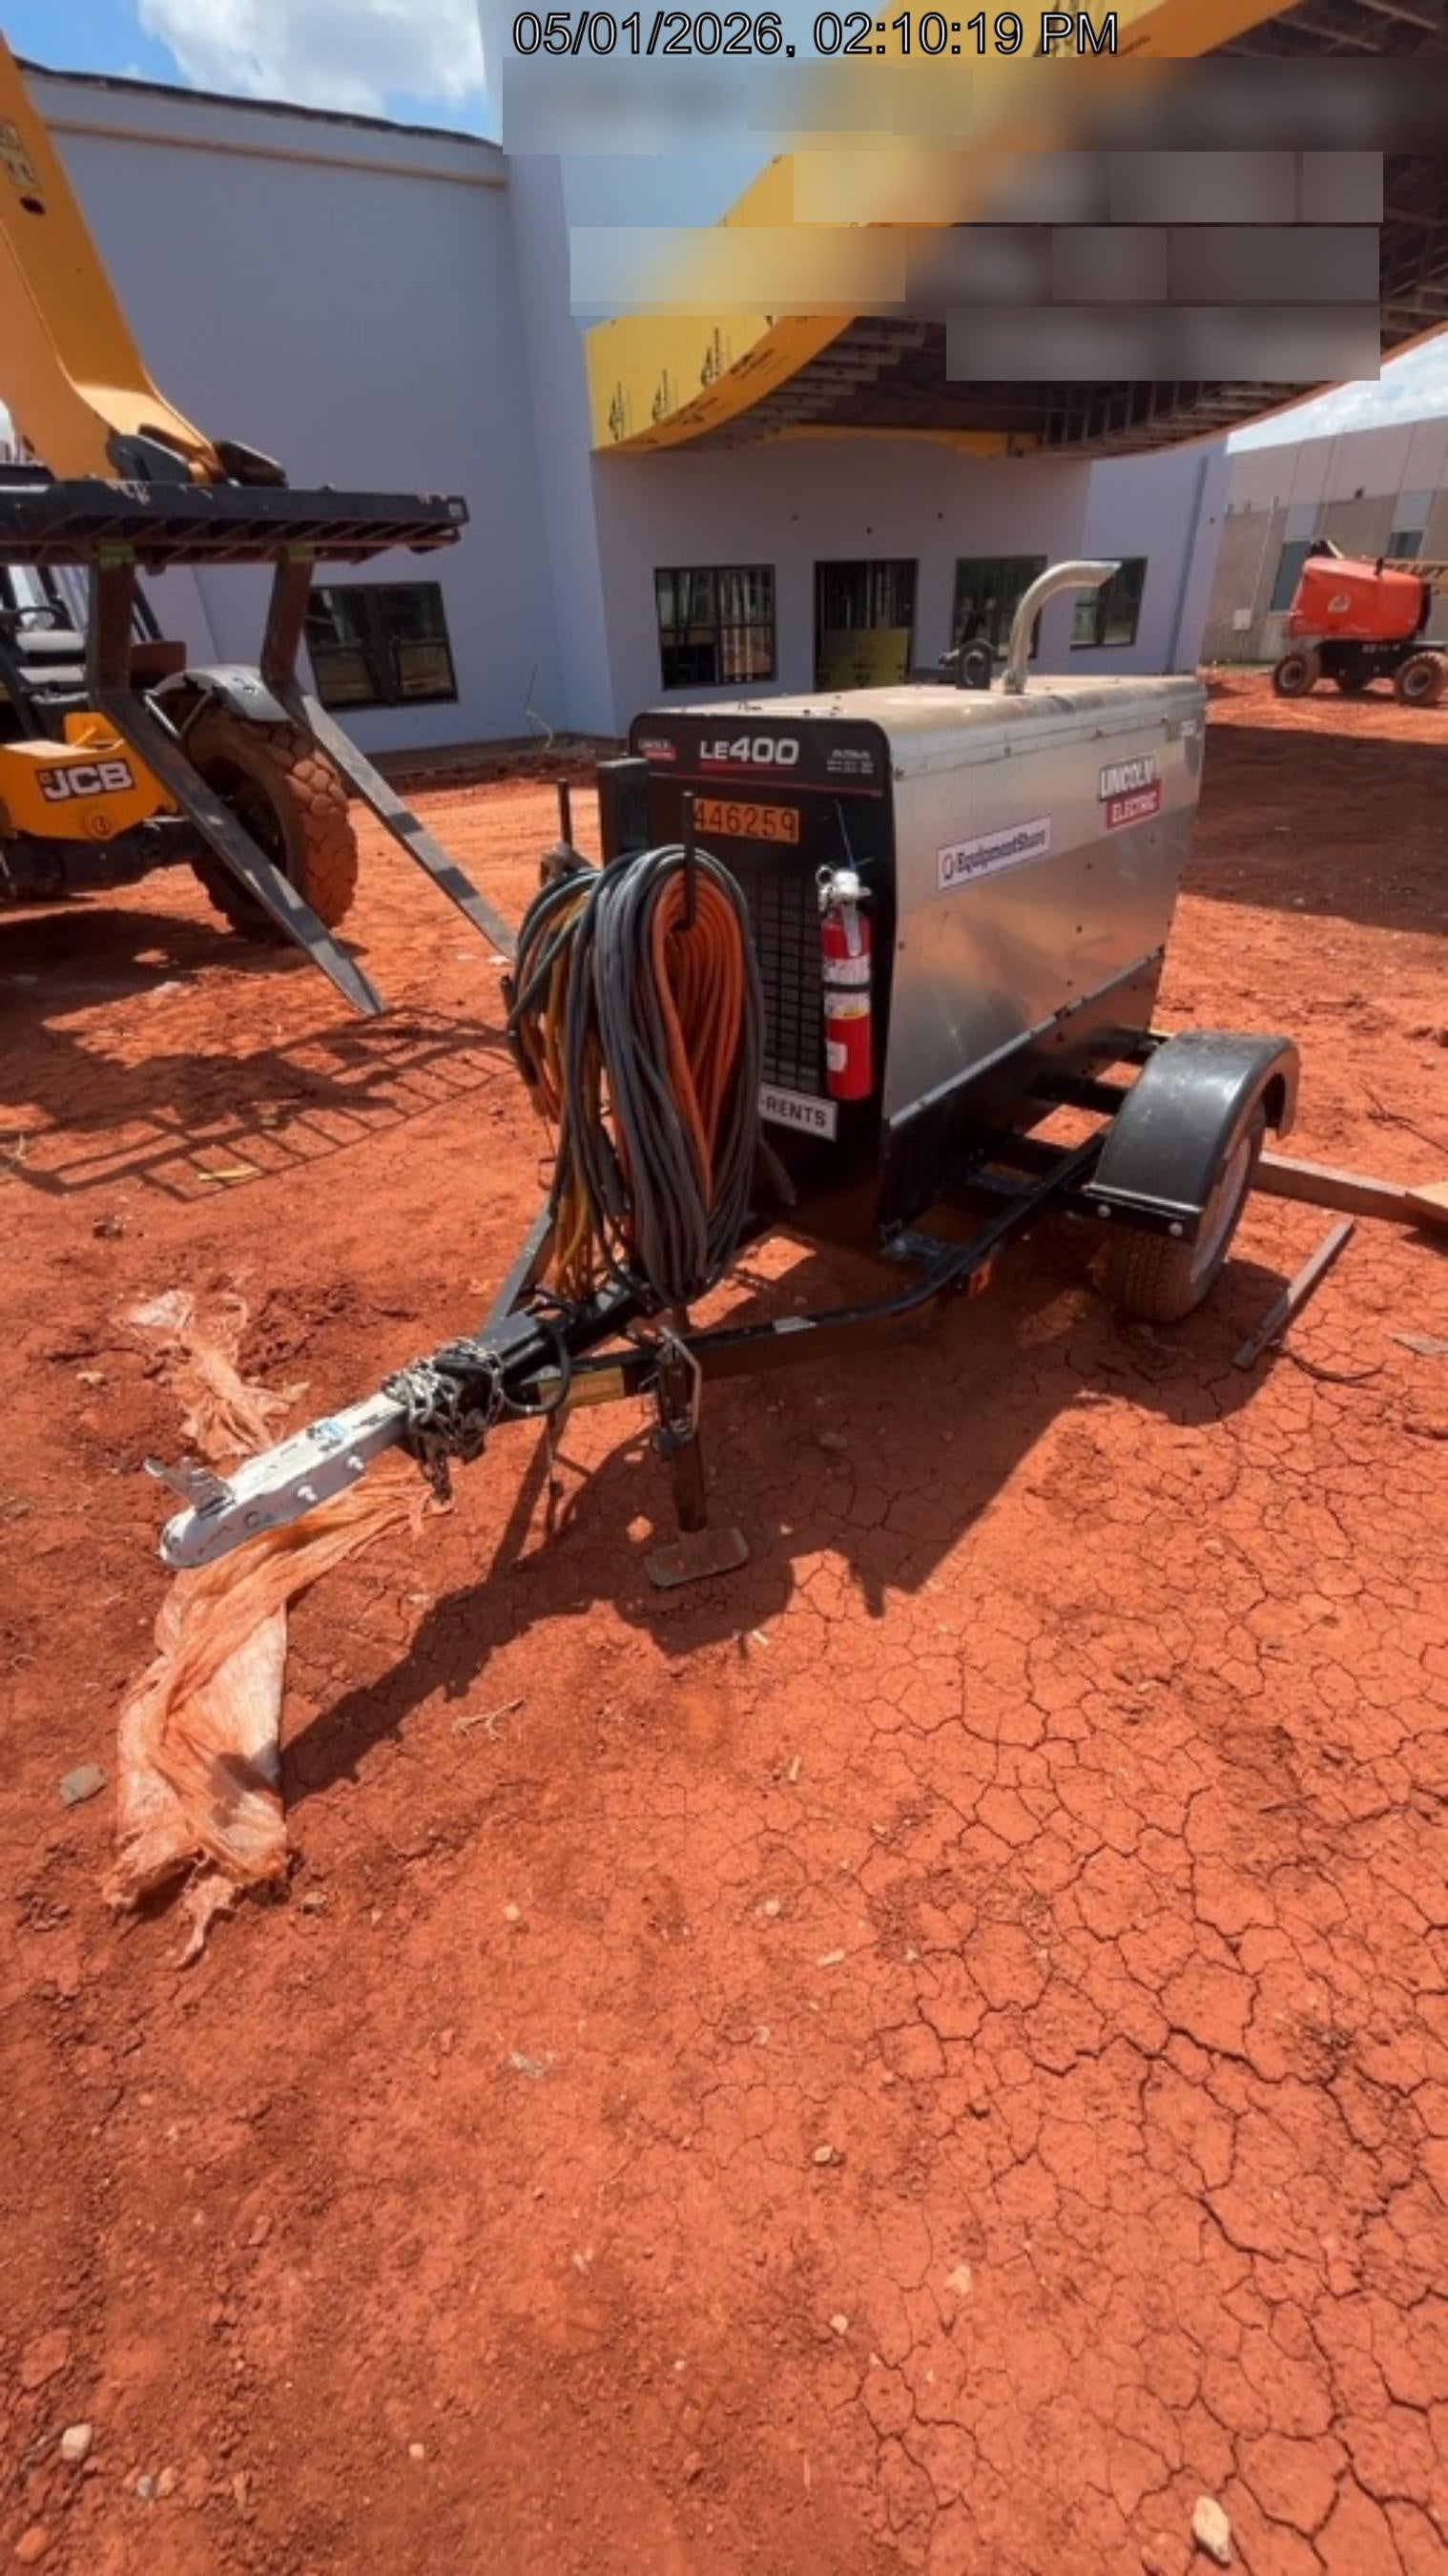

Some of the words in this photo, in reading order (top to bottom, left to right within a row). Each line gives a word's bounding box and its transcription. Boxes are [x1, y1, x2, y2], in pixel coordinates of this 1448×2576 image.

[699, 737, 799, 764] LE400
[41, 760, 134, 800] JCB
[694, 800, 796, 840] 446259
